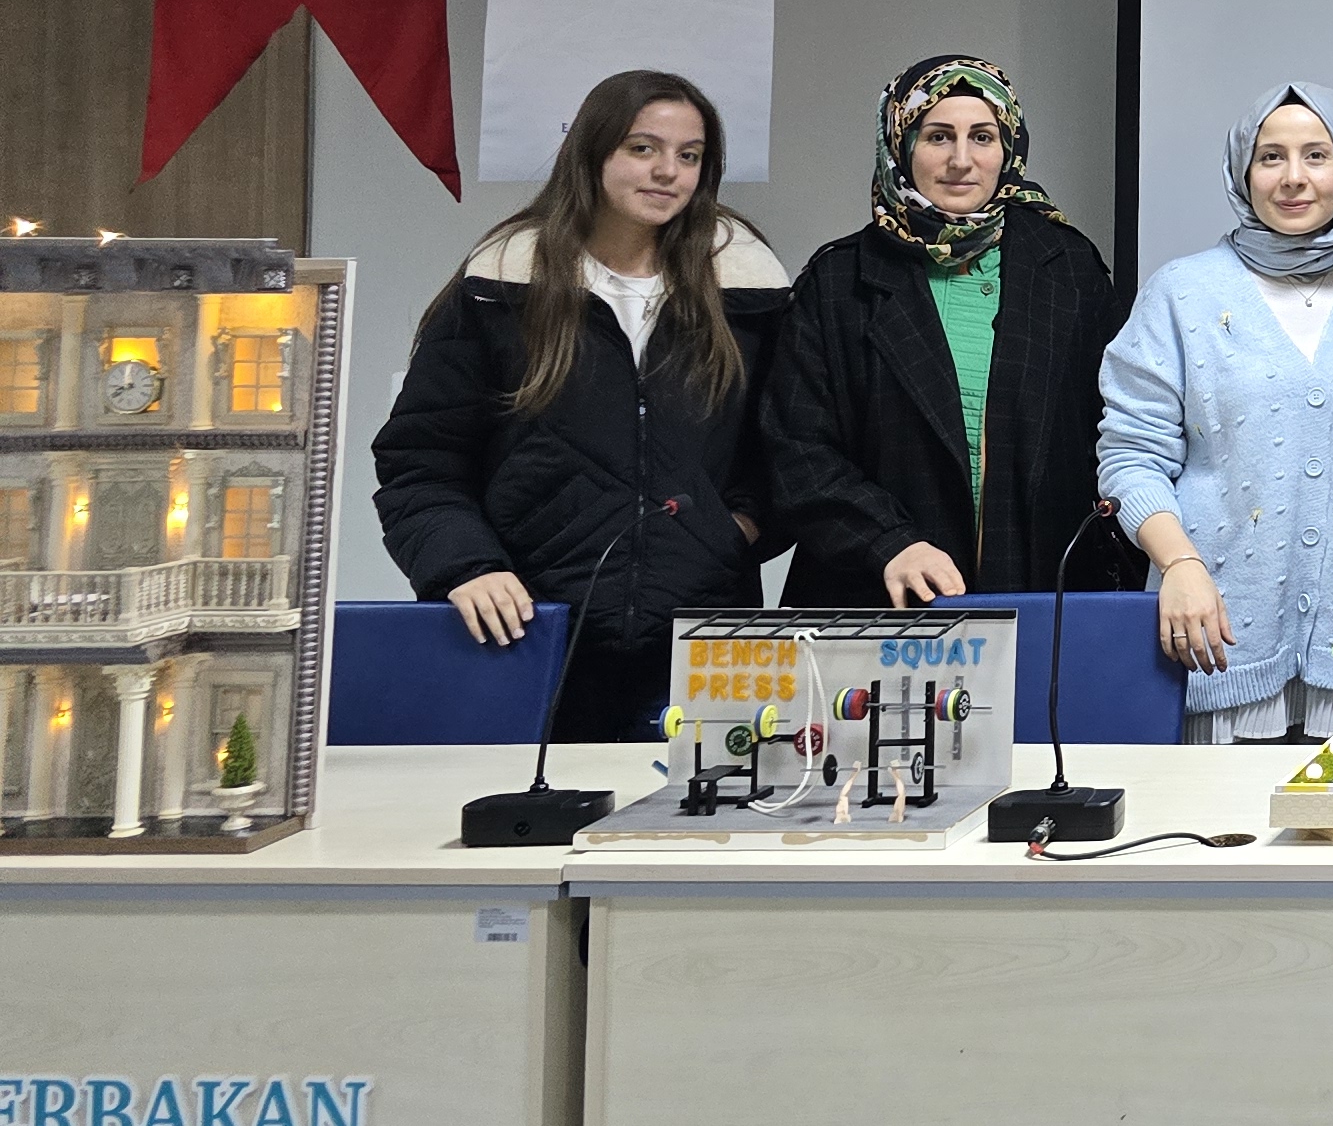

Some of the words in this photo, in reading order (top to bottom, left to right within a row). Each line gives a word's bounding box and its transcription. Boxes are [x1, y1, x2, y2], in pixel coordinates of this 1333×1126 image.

[689, 639, 797, 668] BENCH
[880, 637, 987, 669] SQUAT
[688, 672, 796, 702] PRESS
